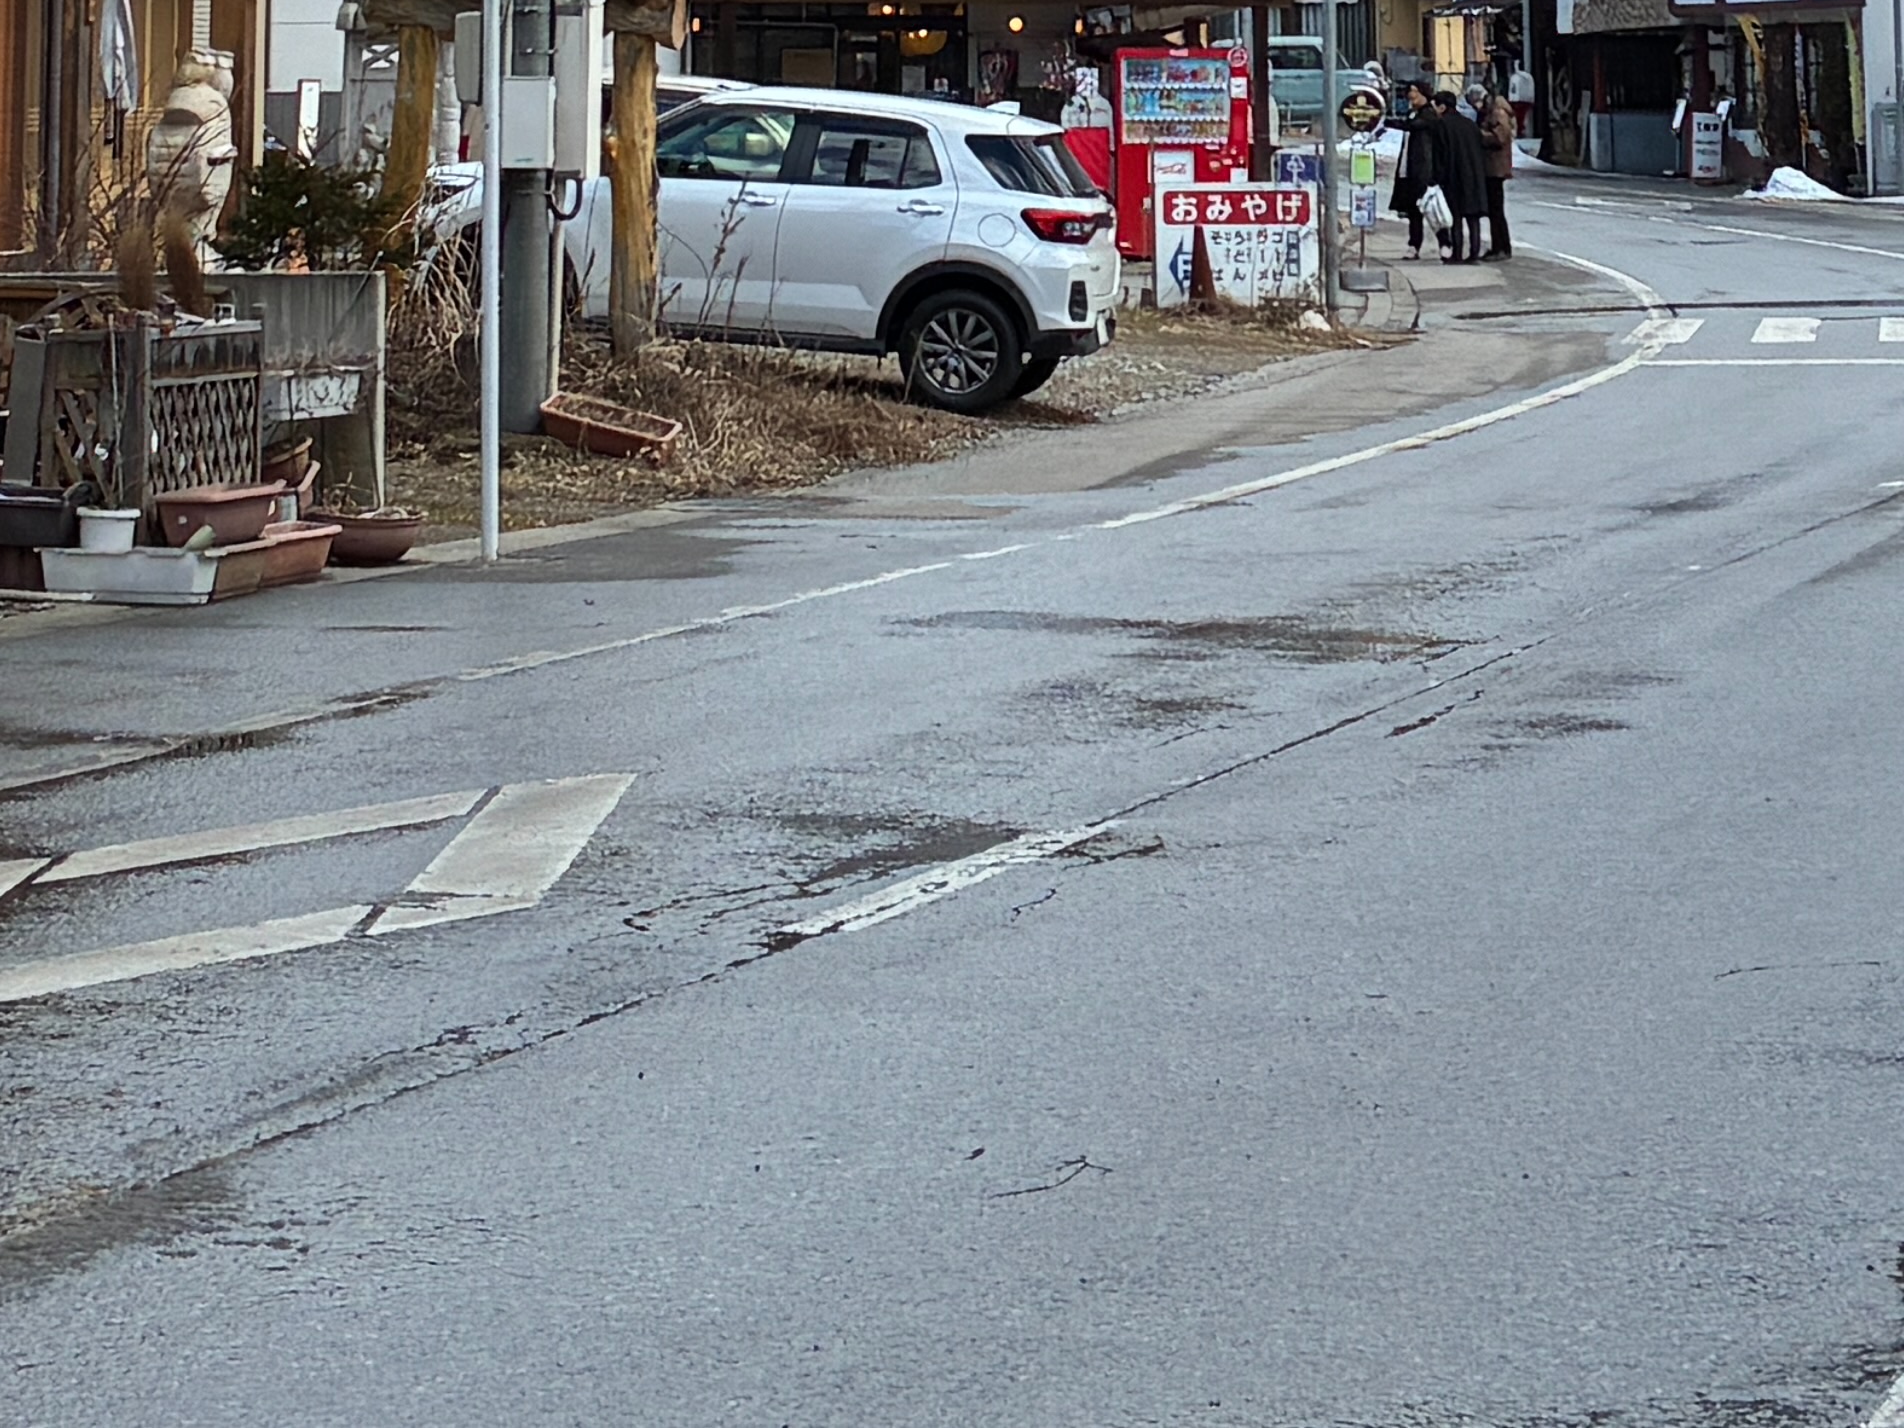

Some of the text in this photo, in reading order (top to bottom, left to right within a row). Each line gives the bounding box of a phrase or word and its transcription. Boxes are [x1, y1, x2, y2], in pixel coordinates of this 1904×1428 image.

[1171, 193, 1303, 223] おみやげ
[1232, 231, 1247, 282] うどん
